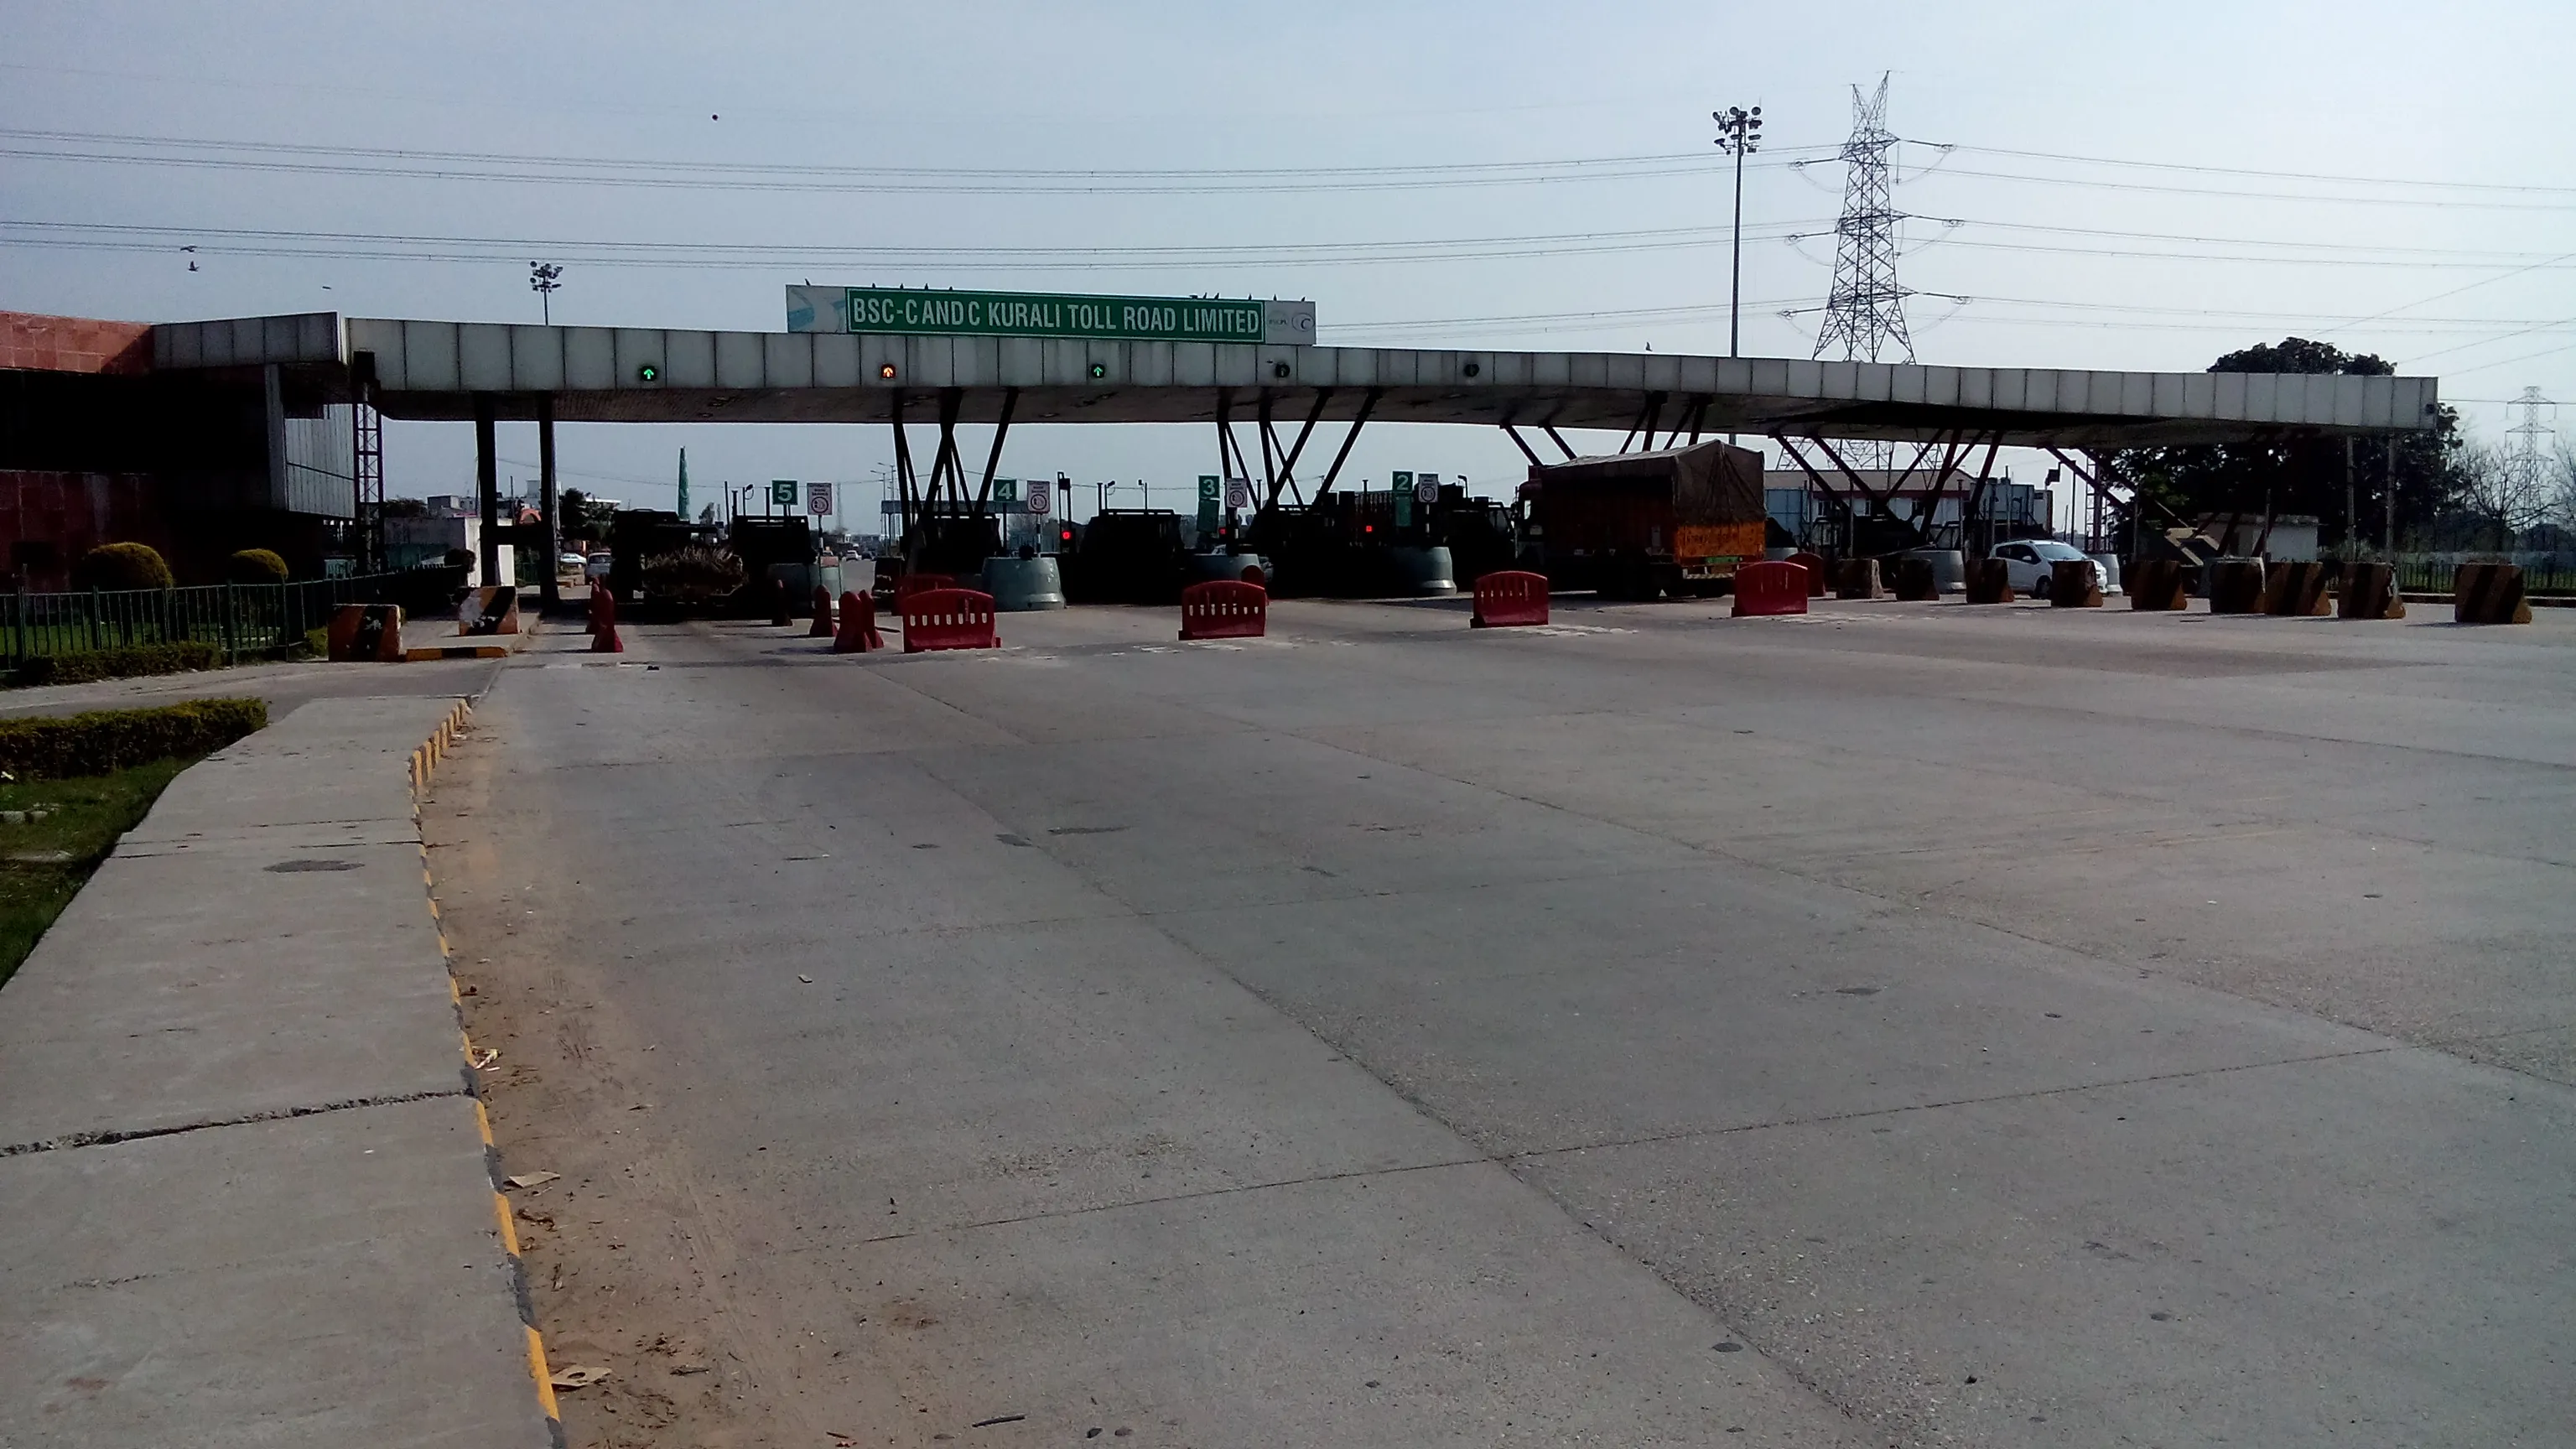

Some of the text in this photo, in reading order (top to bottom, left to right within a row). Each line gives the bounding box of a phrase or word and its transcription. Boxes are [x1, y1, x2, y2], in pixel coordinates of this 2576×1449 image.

[988, 302, 1061, 328] KURALI
[1067, 304, 1116, 330] TOLL
[1124, 306, 1176, 331] ROAD
[1183, 308, 1259, 334] LIMITED
[997, 482, 1013, 500] 4
[1202, 479, 1216, 496] 3
[1396, 474, 1409, 491] 2
[777, 484, 792, 501] 5
